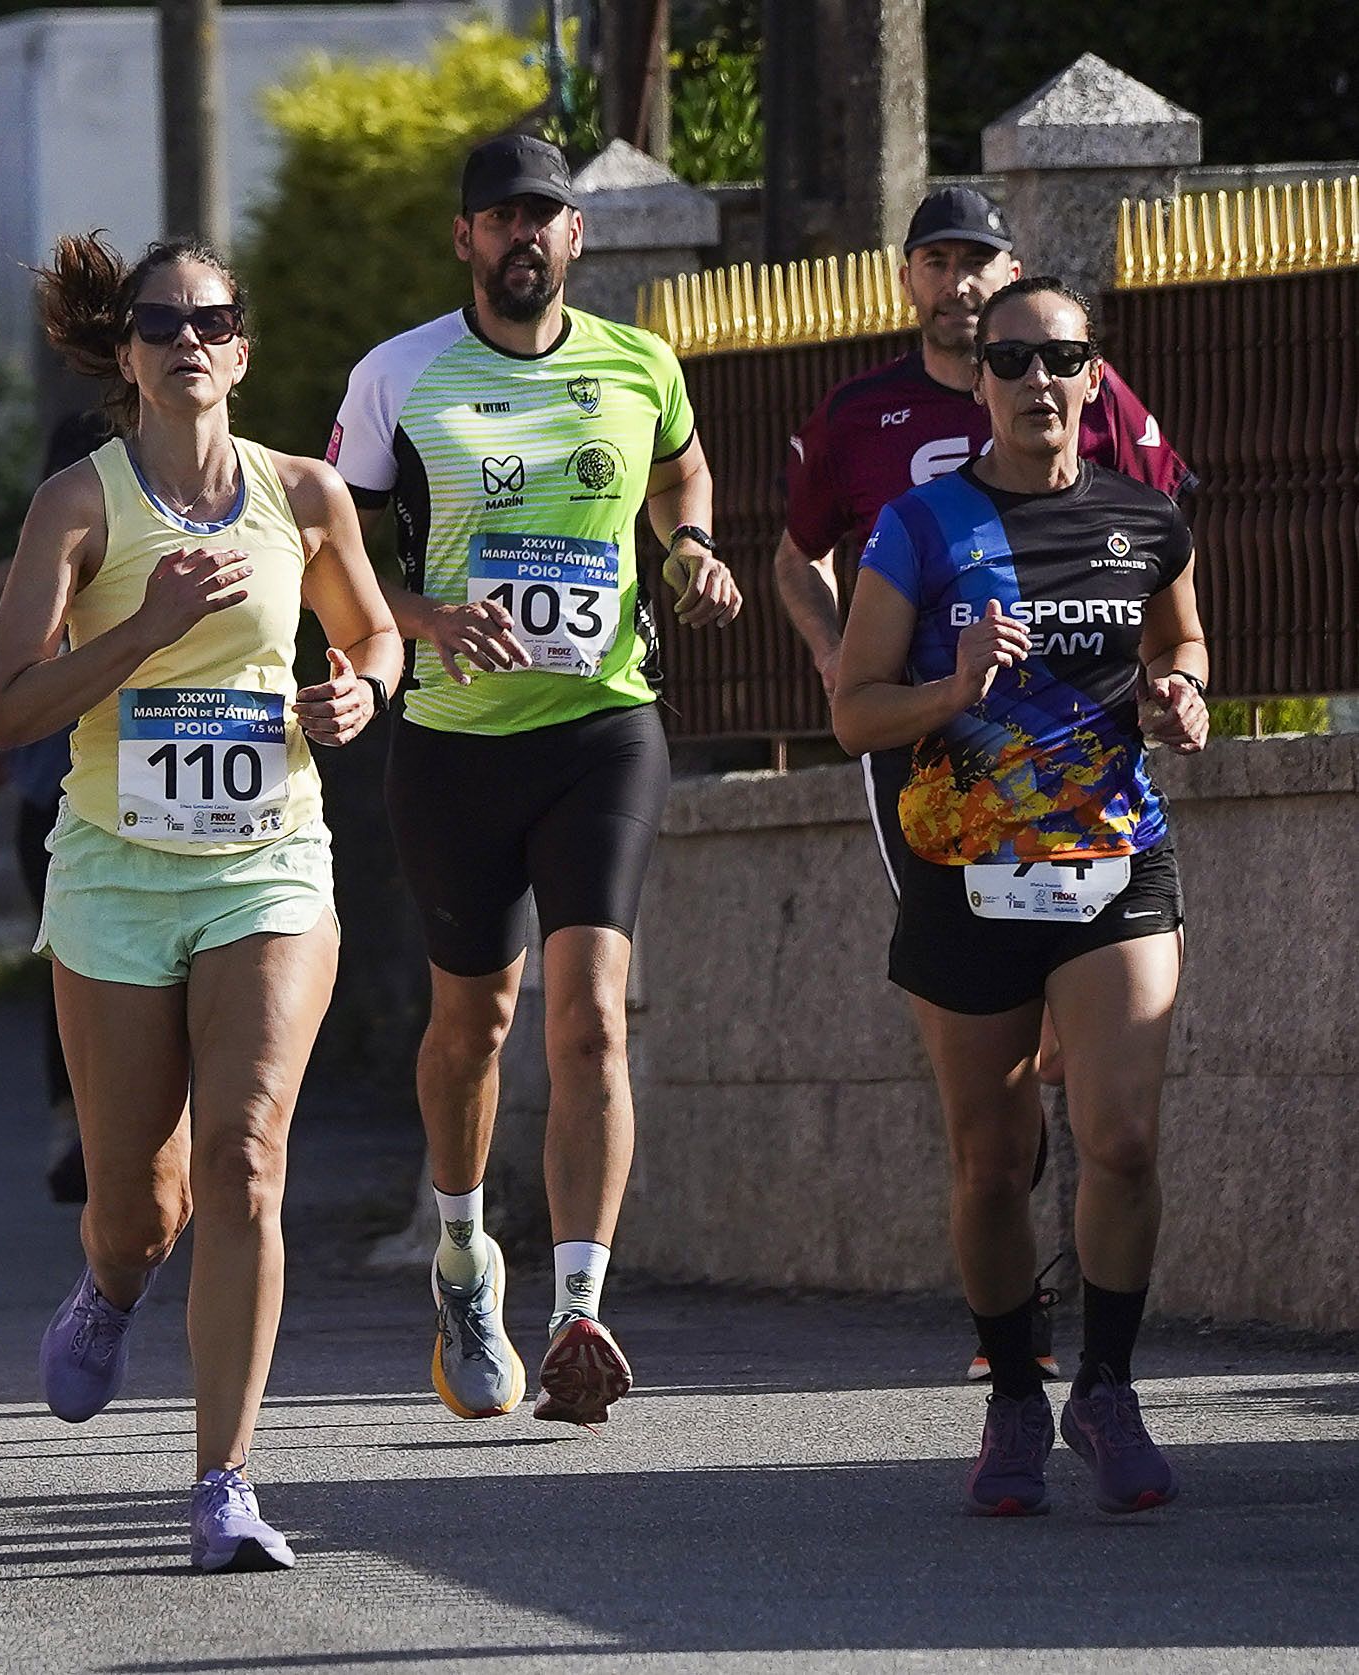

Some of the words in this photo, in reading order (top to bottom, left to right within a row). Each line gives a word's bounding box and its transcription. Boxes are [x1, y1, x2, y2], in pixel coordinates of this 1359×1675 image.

[881, 408, 911, 428] PCF
[485, 494, 525, 511] MARÍN
[521, 537, 566, 550] XXXVII
[482, 549, 540, 561] MARATÓN
[554, 550, 606, 569] FÁTIMA
[517, 564, 562, 578] POIO
[586, 569, 601, 579] 7.5
[486, 582, 603, 639] 103
[951, 603, 979, 627] B
[1009, 600, 1142, 625] SPORTS
[1027, 632, 1105, 656] EAM
[177, 692, 226, 704] XXXVII
[134, 705, 198, 718] MARATÓN
[214, 704, 270, 722] FÁTIMA
[174, 722, 223, 735] POIO
[249, 724, 265, 733] 7.5
[267, 725, 284, 734] KM
[147, 743, 263, 801] 110
[211, 813, 236, 821] FROIZ
